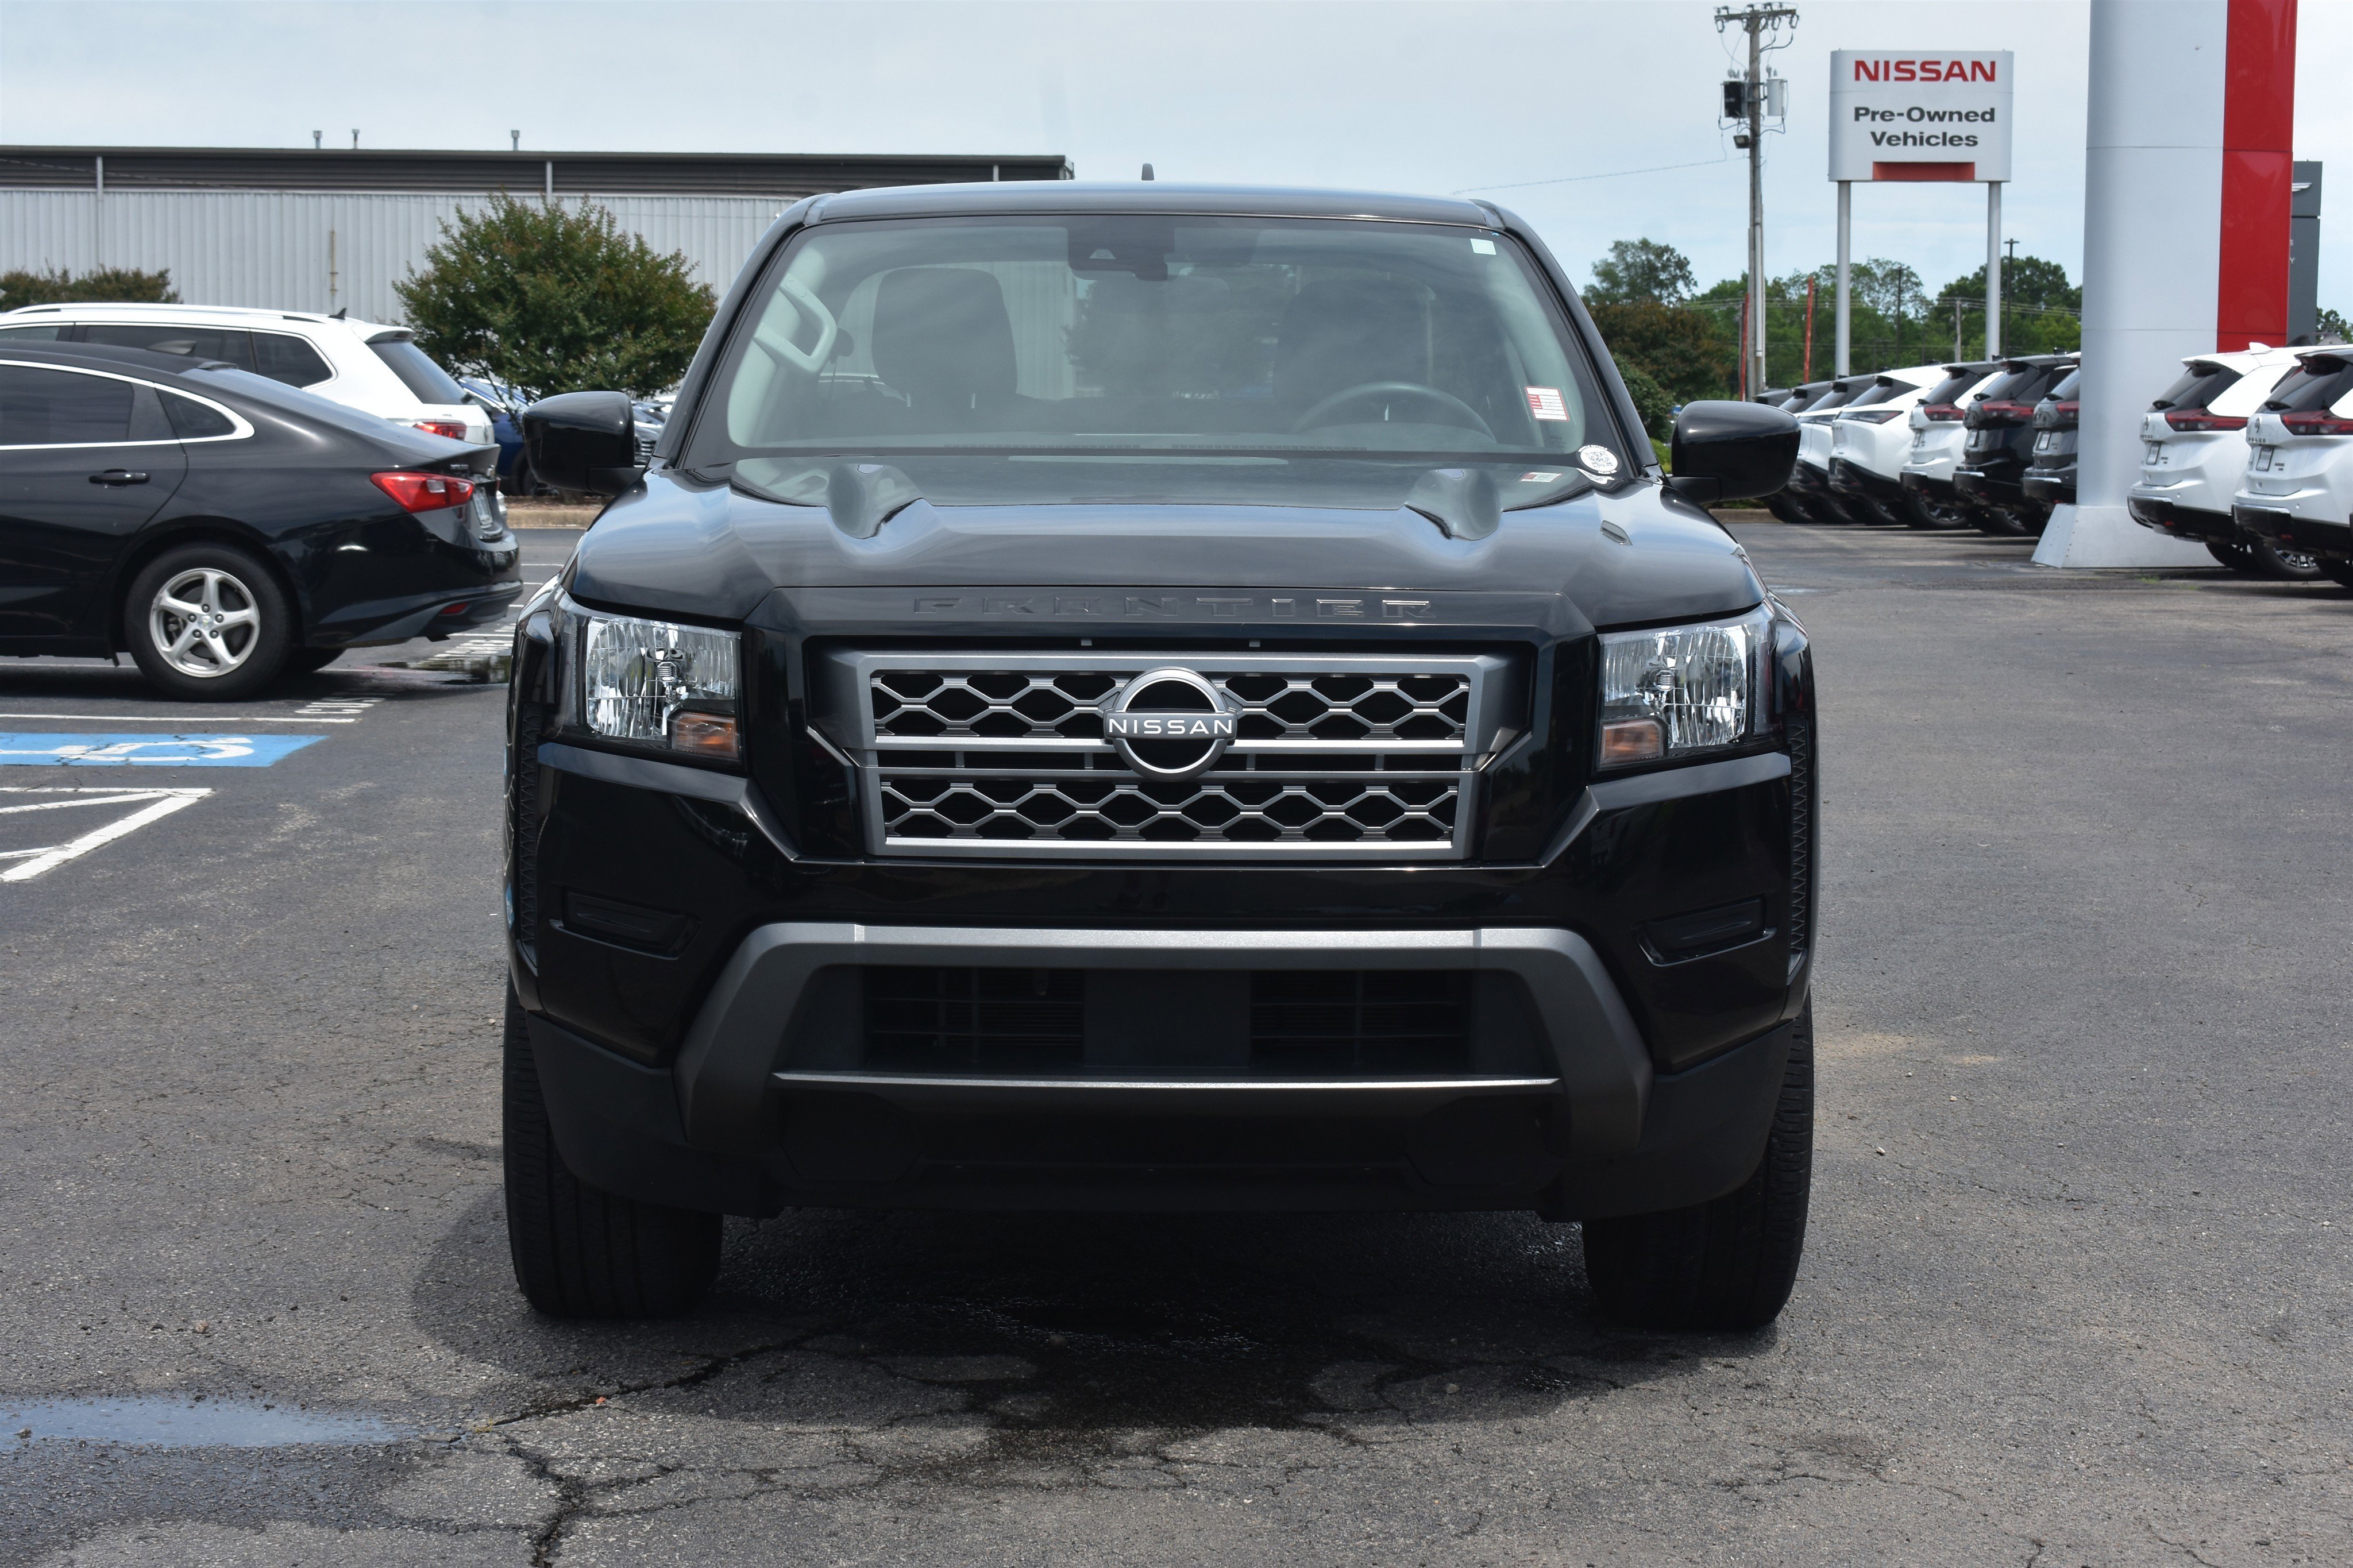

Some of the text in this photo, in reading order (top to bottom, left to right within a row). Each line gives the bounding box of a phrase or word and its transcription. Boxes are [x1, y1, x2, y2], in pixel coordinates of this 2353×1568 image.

[1854, 60, 1996, 82] NISSAN
[1854, 106, 1995, 122] Pre-Owned
[1870, 131, 1978, 147] Vehicles
[914, 597, 1436, 618] FRONTIER
[1109, 718, 1232, 735] NISSAN
